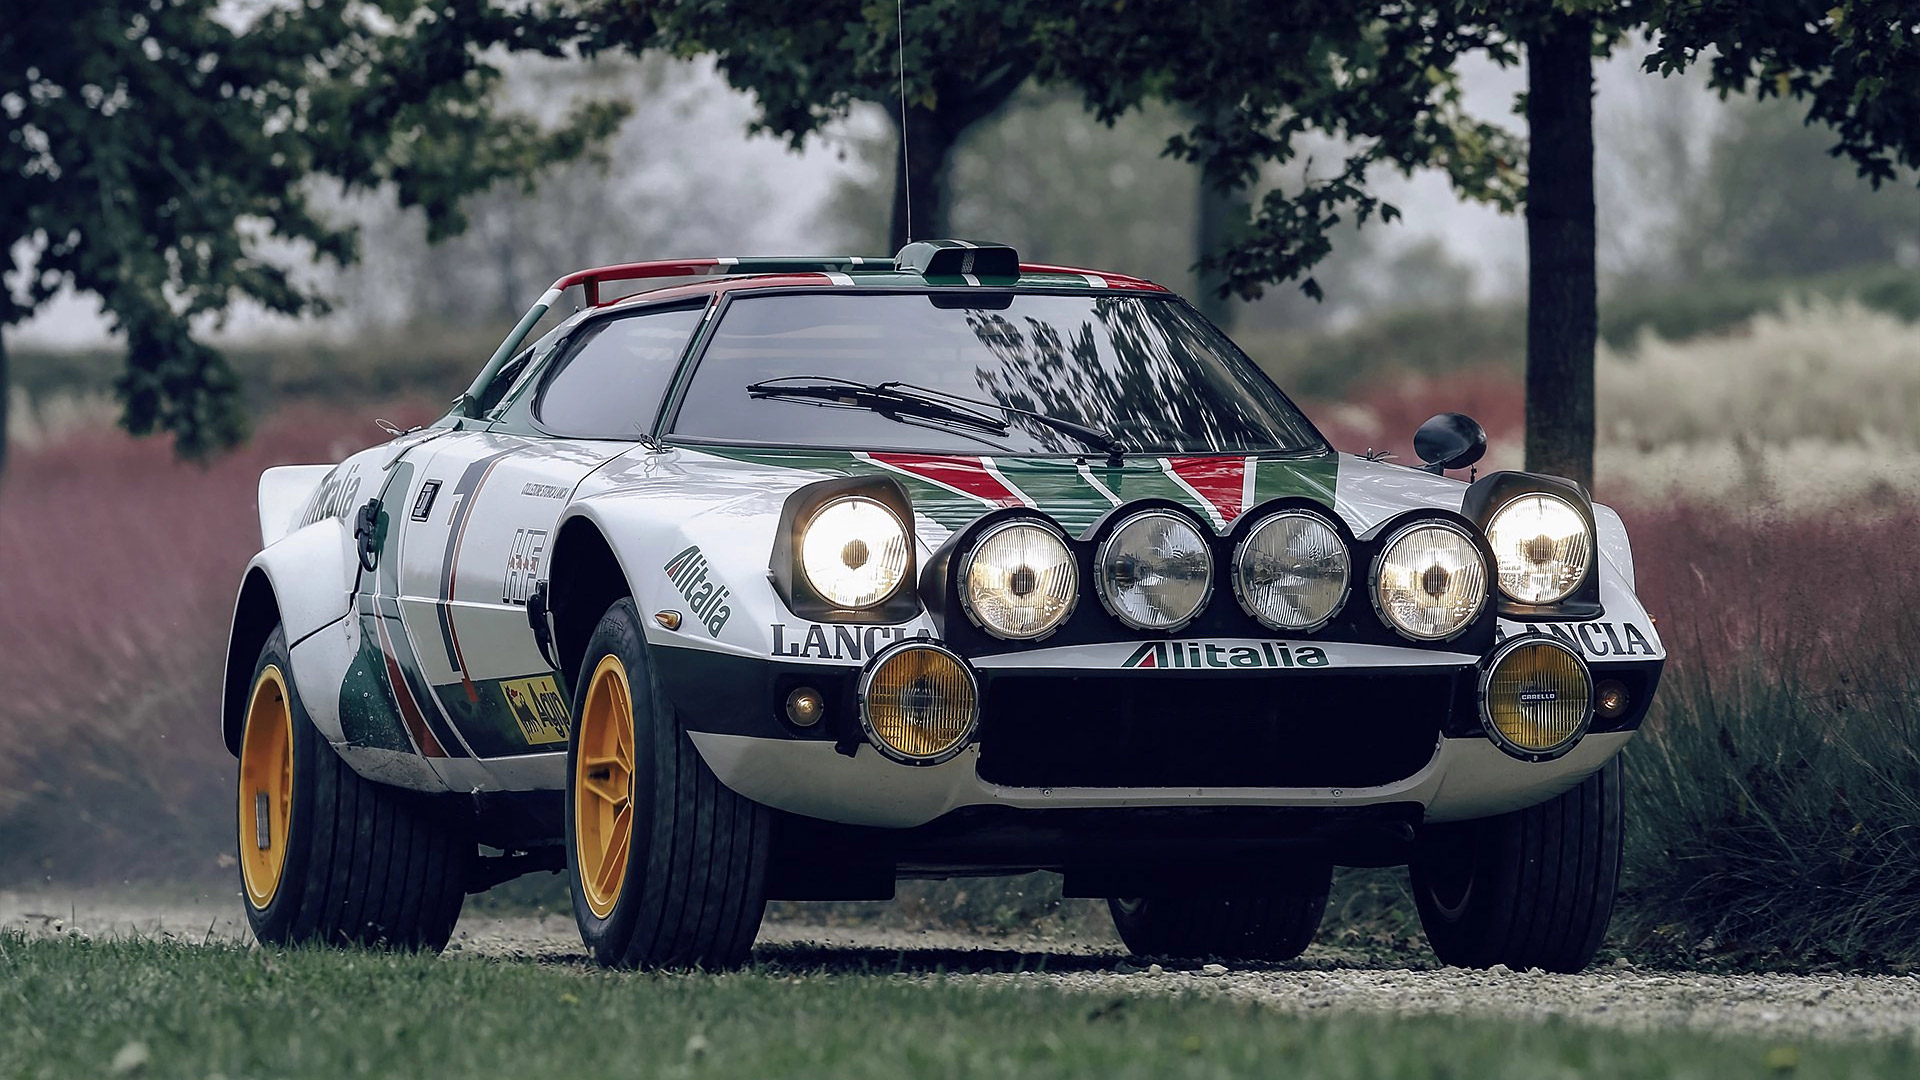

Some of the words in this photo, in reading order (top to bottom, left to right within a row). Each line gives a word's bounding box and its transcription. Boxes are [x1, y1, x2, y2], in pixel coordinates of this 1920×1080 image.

[663, 545, 731, 639] Alitalia
[1121, 642, 1330, 668] Alitalia
[527, 681, 571, 738] Agip
[1521, 692, 1555, 701] CARELLO
